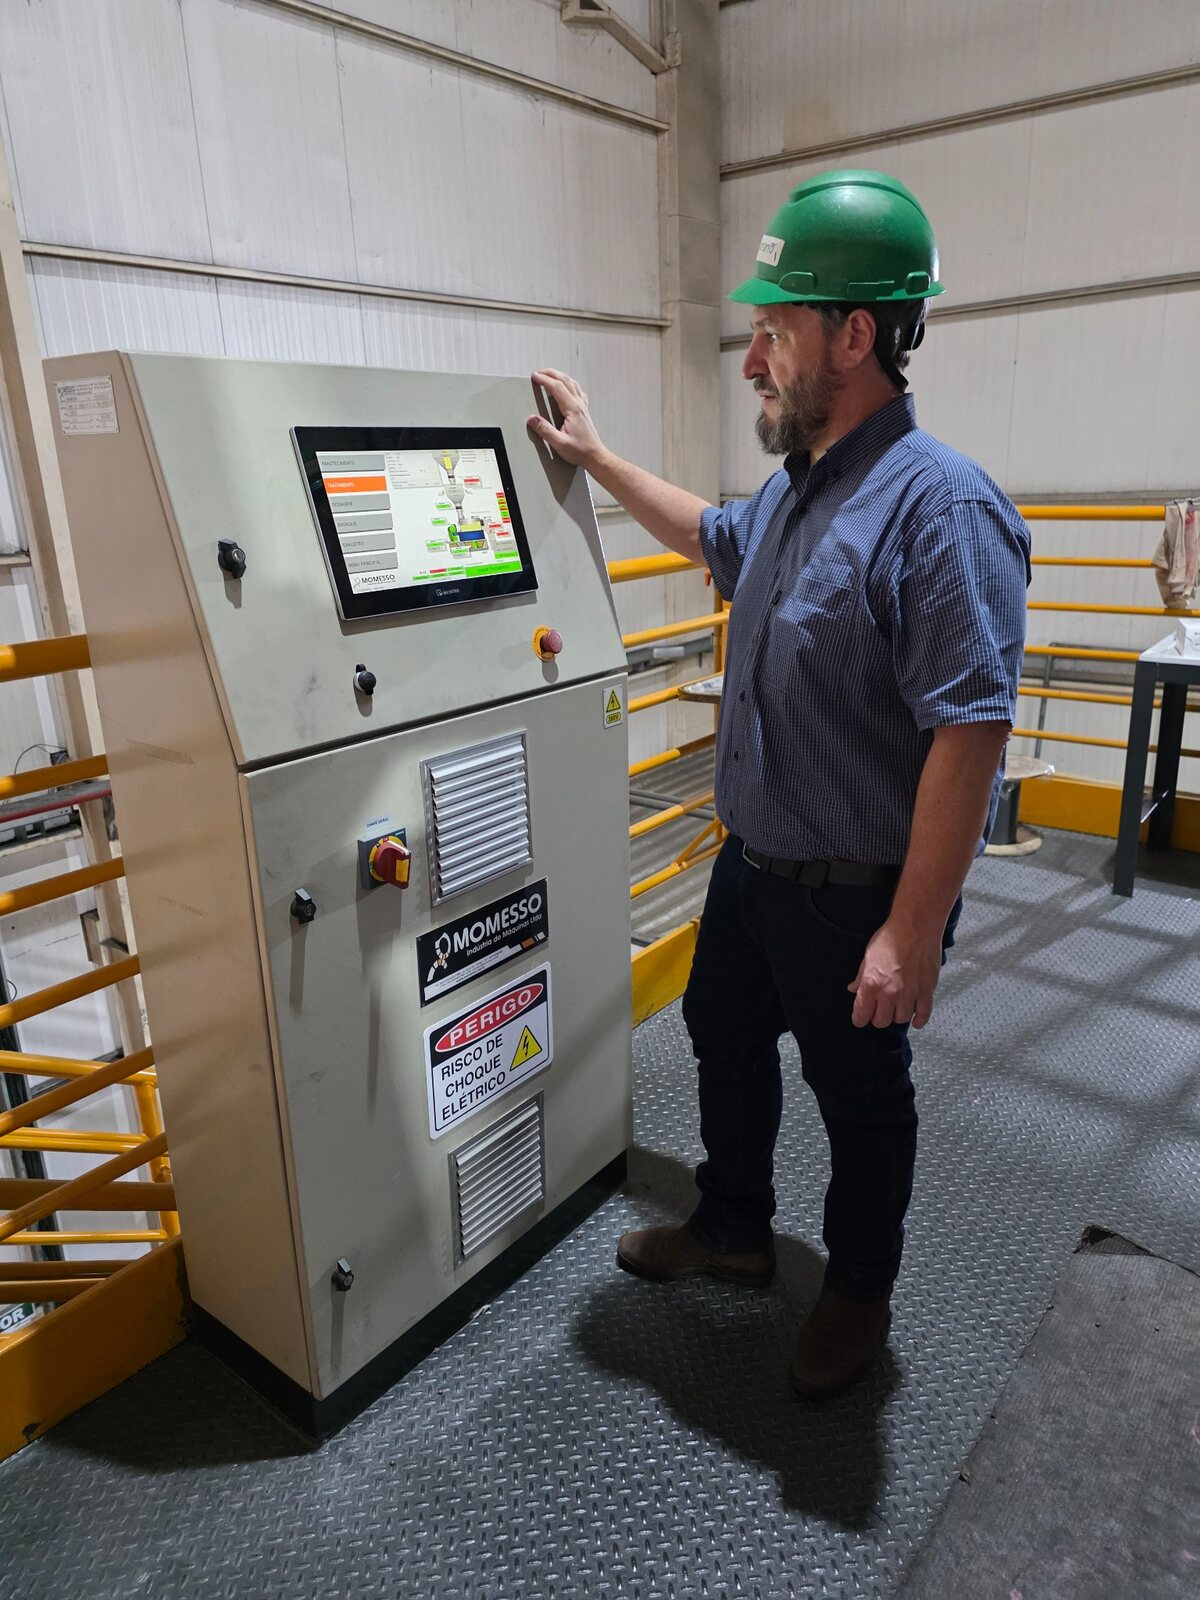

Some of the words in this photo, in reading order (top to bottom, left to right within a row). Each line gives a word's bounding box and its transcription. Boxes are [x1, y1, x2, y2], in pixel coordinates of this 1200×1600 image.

[361, 574, 396, 584] MOMESSO
[453, 893, 542, 953] MOMESSO
[466, 936, 493, 957] Indústria
[493, 933, 502, 943] de
[502, 921, 530, 940] Máquinas
[530, 912, 543, 924] Ltda
[450, 989, 532, 1047] PERIGO
[441, 1050, 483, 1081] RISCO
[486, 1033, 504, 1054] DE
[445, 1054, 502, 1098] CHOQUE
[442, 1071, 506, 1121] ELÉTRICO
